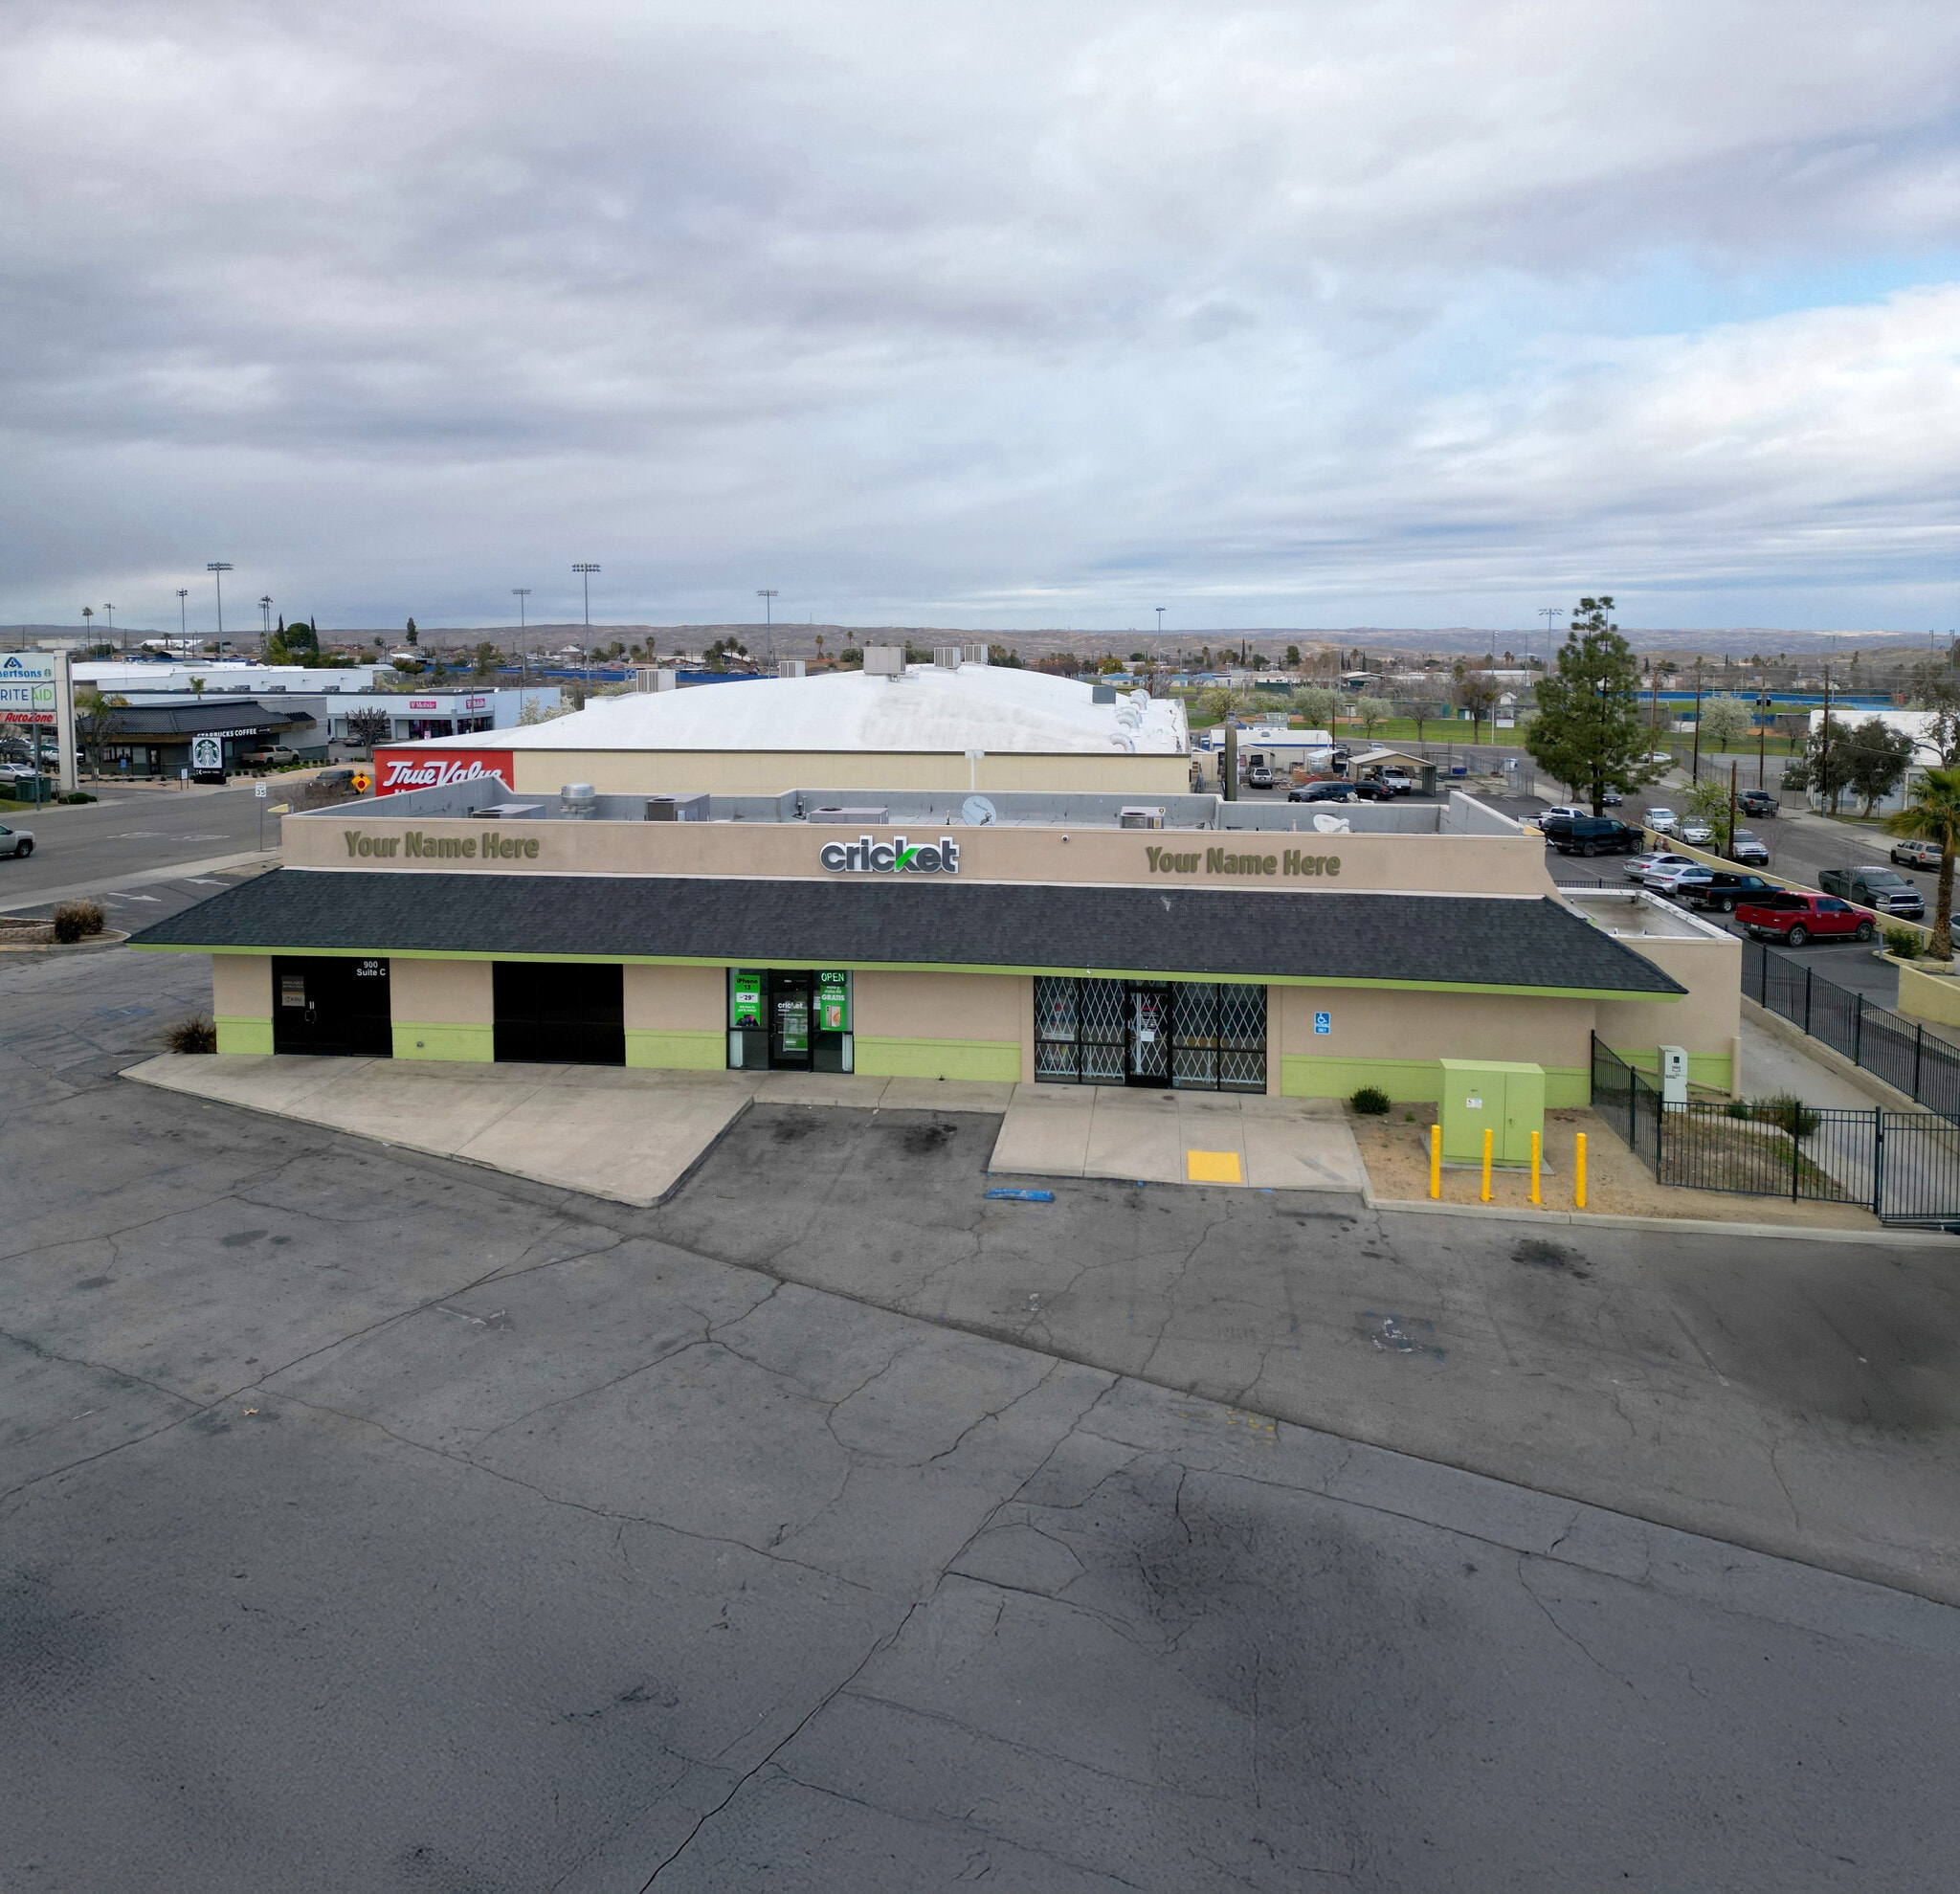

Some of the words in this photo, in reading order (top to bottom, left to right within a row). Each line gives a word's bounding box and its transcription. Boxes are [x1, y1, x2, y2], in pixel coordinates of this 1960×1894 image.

[0, 689, 30, 701] RITE
[32, 689, 53, 701] AID
[5, 712, 54, 723] AutoZone
[234, 728, 256, 737] COFFEE
[383, 761, 436, 786] True
[345, 831, 400, 858] Your
[405, 831, 477, 858] Name
[481, 832, 540, 858] Here
[820, 836, 960, 873] cricket
[1146, 846, 1202, 873] Your
[1206, 847, 1278, 875] Name
[1283, 849, 1341, 876] Here
[821, 972, 844, 982] OPEN
